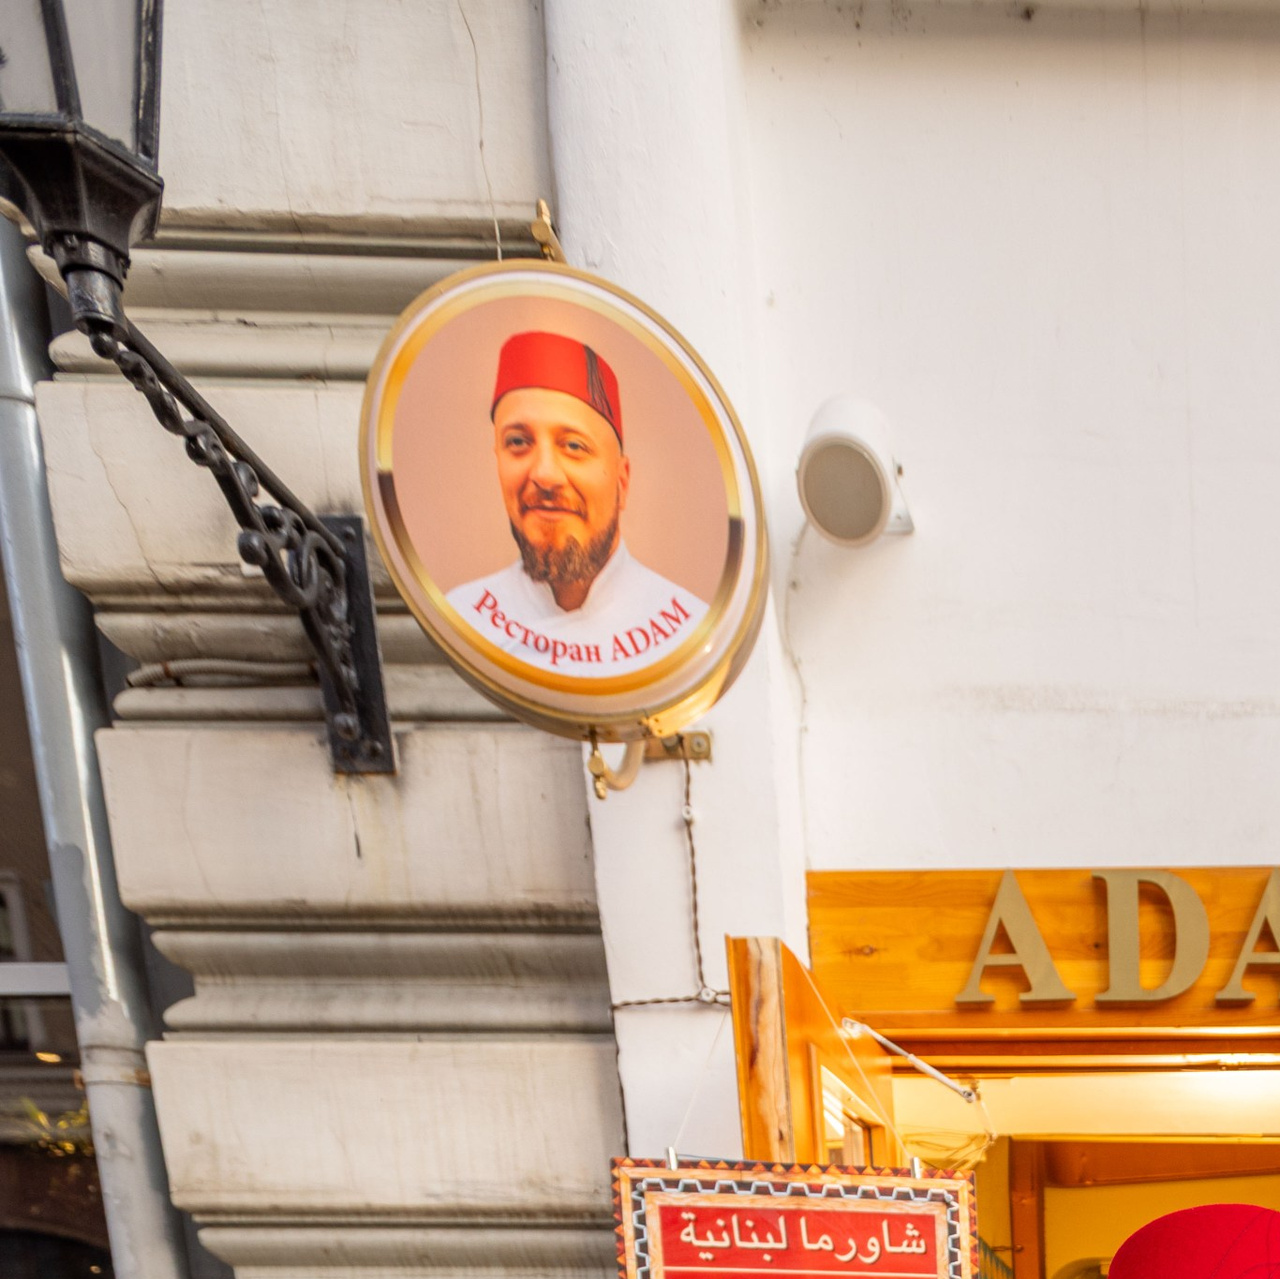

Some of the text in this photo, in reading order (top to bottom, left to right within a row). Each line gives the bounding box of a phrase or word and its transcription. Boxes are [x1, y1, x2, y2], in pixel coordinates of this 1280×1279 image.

[472, 588, 693, 666] Ресторан ADAM
[678, 1211, 927, 1264] شاورما لبنانية
